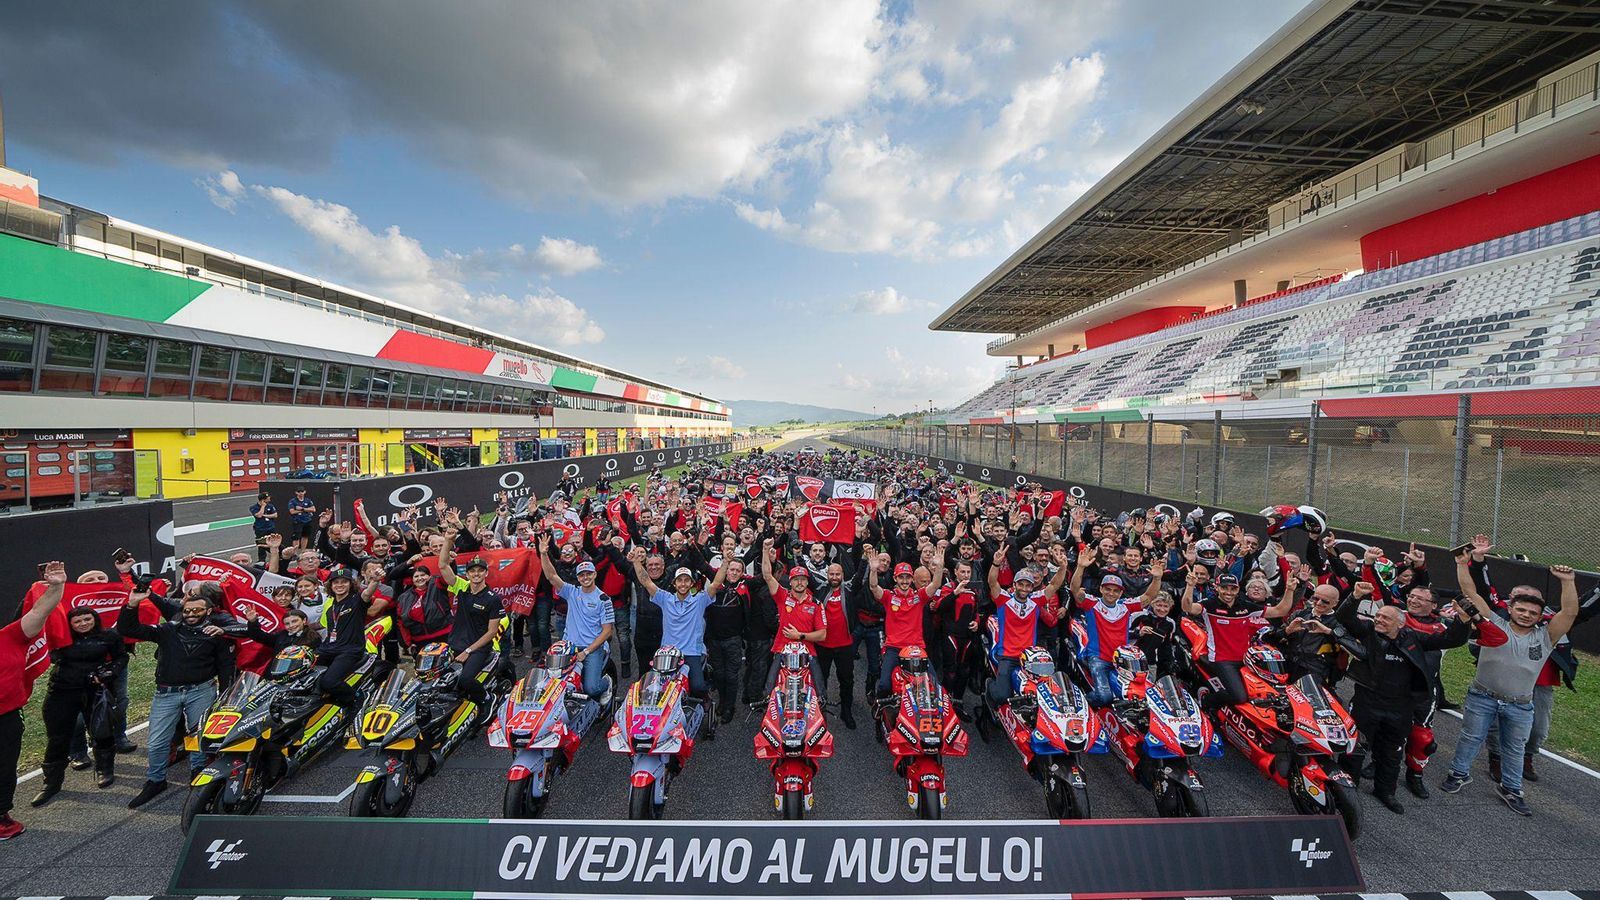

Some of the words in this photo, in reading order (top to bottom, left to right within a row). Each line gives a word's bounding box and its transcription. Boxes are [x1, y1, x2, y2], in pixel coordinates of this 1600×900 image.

[493, 486, 531, 502] OKLEY
[813, 508, 837, 516] DUCATI
[189, 563, 248, 584] DUCTI
[77, 597, 126, 606] DUCATI
[1038, 685, 1055, 708] OCTO
[1147, 688, 1166, 712] OCTO
[238, 715, 267, 732] mooney
[364, 711, 393, 734] 10
[391, 717, 415, 737] mooney
[506, 710, 545, 731] 49
[631, 714, 661, 734] 23
[920, 718, 943, 733] 63
[1297, 722, 1320, 736] Lenovo
[762, 726, 779, 748] Lenovo
[807, 726, 825, 747] Lenovo
[898, 723, 917, 744] Lenovo
[945, 724, 960, 744] Lenovo
[498, 835, 547, 881] CI
[555, 836, 753, 883] VEDIAMO
[758, 838, 813, 884] AL
[824, 837, 1043, 884] MUGELLO!
